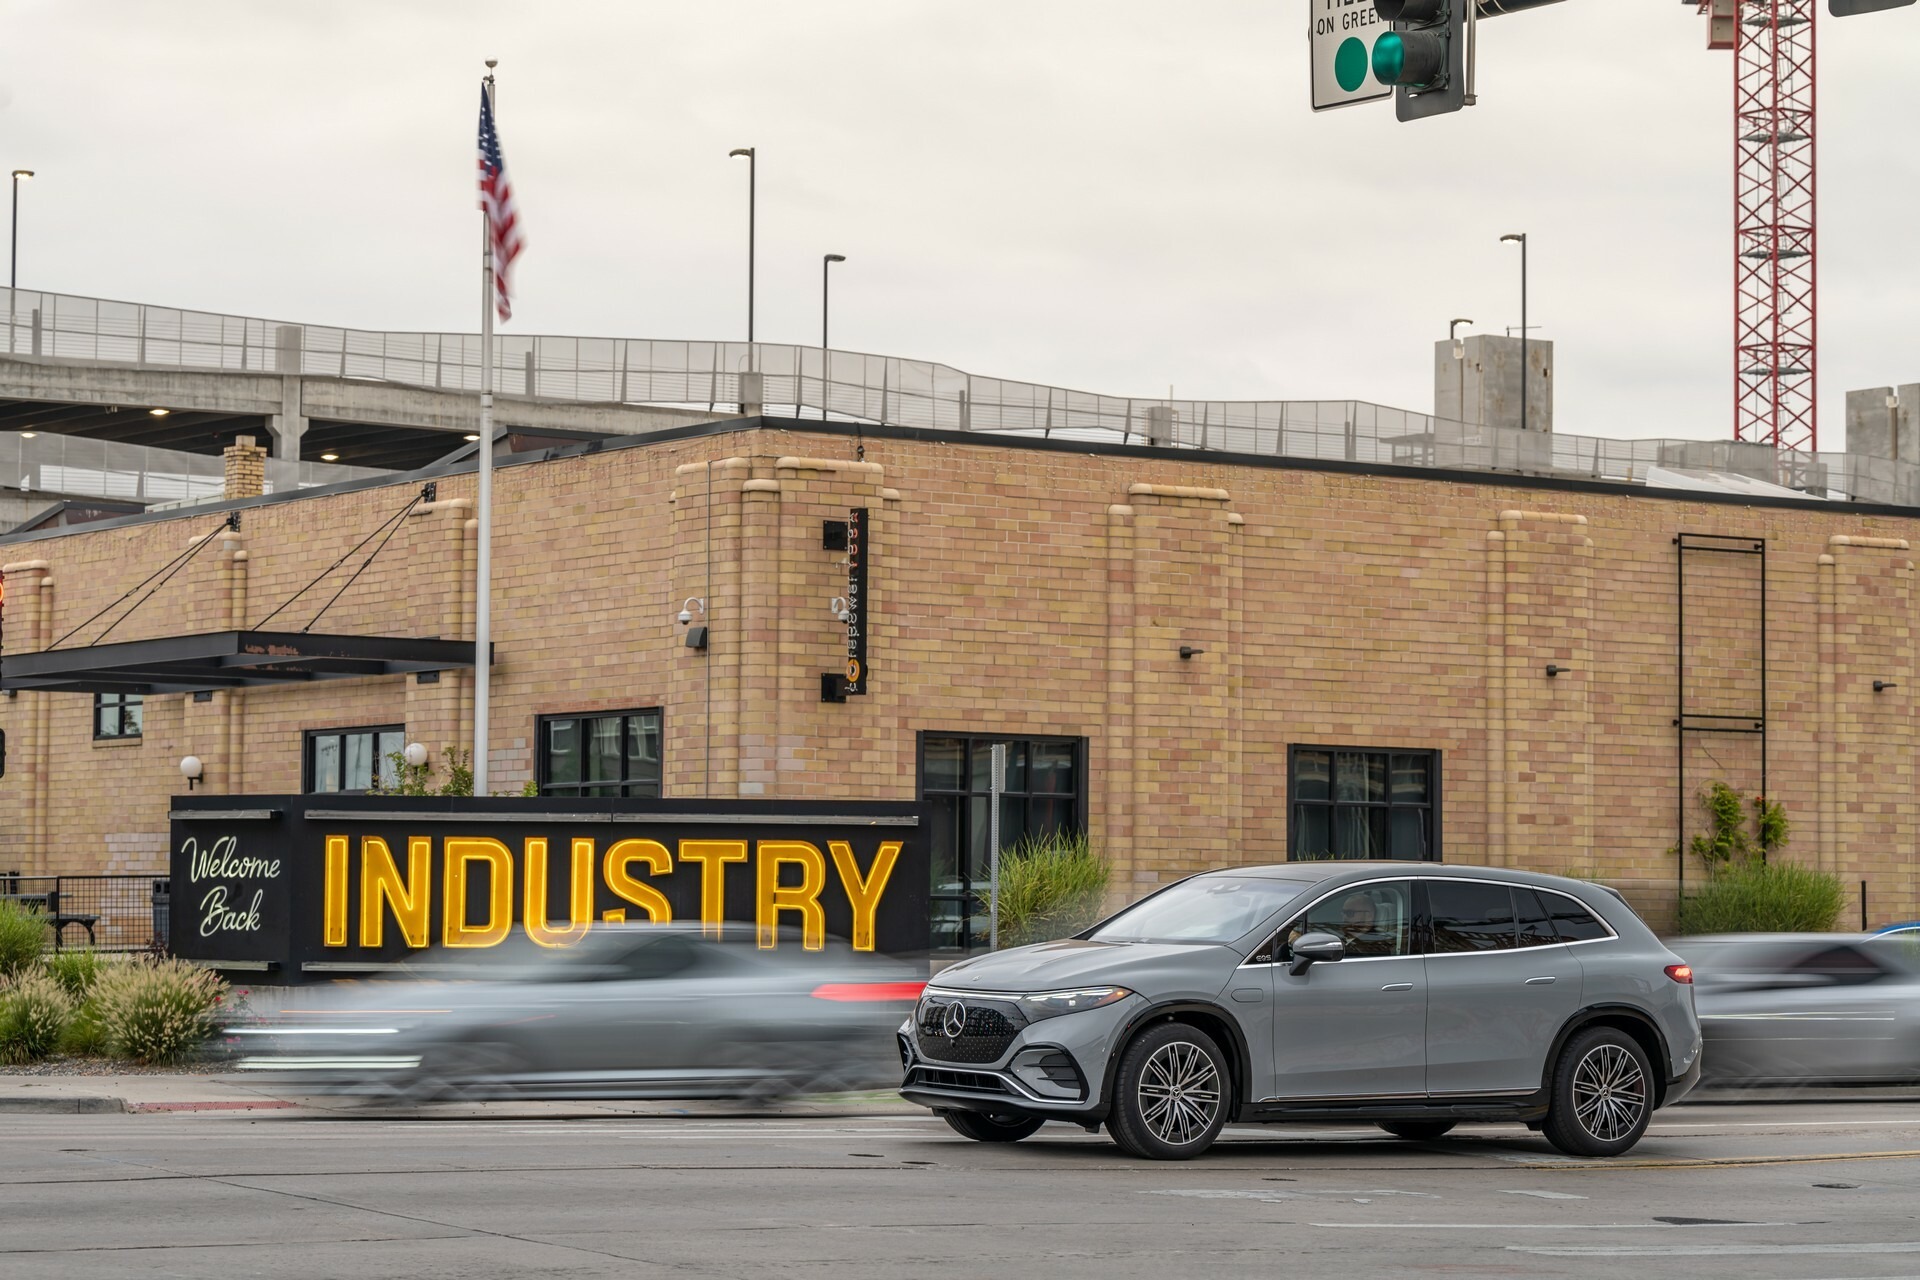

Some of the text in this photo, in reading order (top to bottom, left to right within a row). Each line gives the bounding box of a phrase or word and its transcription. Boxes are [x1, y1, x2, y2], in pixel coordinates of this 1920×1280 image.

[1317, 16, 1334, 35] ON
[181, 836, 280, 883] Welcome
[200, 886, 263, 937] Back
[324, 834, 904, 952] INDUSTRY
